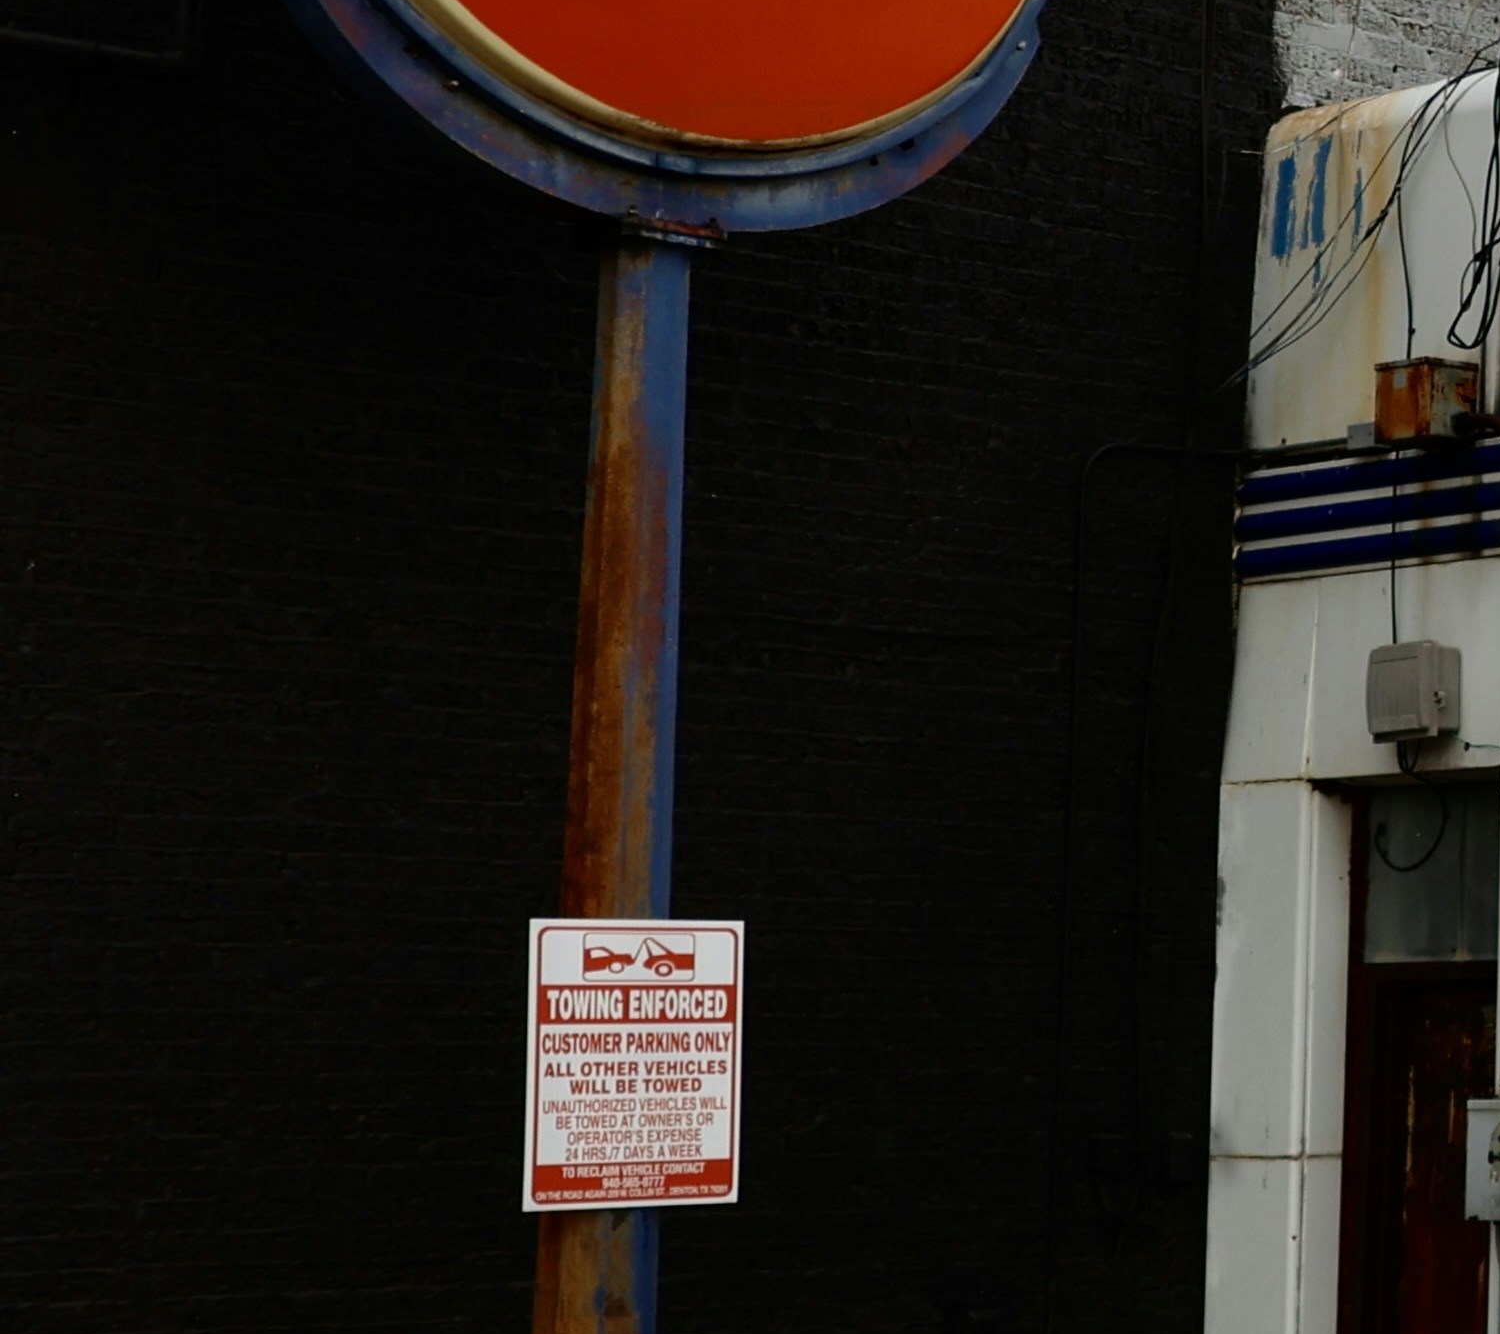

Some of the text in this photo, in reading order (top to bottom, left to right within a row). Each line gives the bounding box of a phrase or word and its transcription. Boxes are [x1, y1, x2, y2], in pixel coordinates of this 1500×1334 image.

[547, 989, 728, 1021] TOWING ENFORCED
[542, 1032, 732, 1055] CUSTOMER PARKING ONLY
[544, 1060, 727, 1078] ALL OTHER VEHICLES
[570, 1078, 702, 1095] WILL BE TOWED
[543, 1096, 727, 1114] UNAUTHORIZED VEHICLES WILL
[556, 1112, 714, 1130] BE TOWED AT OWNER'S OR
[567, 1129, 702, 1145] OPERATOR'S EXPENSE
[565, 1148, 579, 1162] 24
[625, 1146, 655, 1160] DAYS
[657, 1145, 667, 1158] A
[668, 1144, 703, 1158] WEEK
[562, 1162, 706, 1179] TO RECLAIM VEHICLE CONTACT
